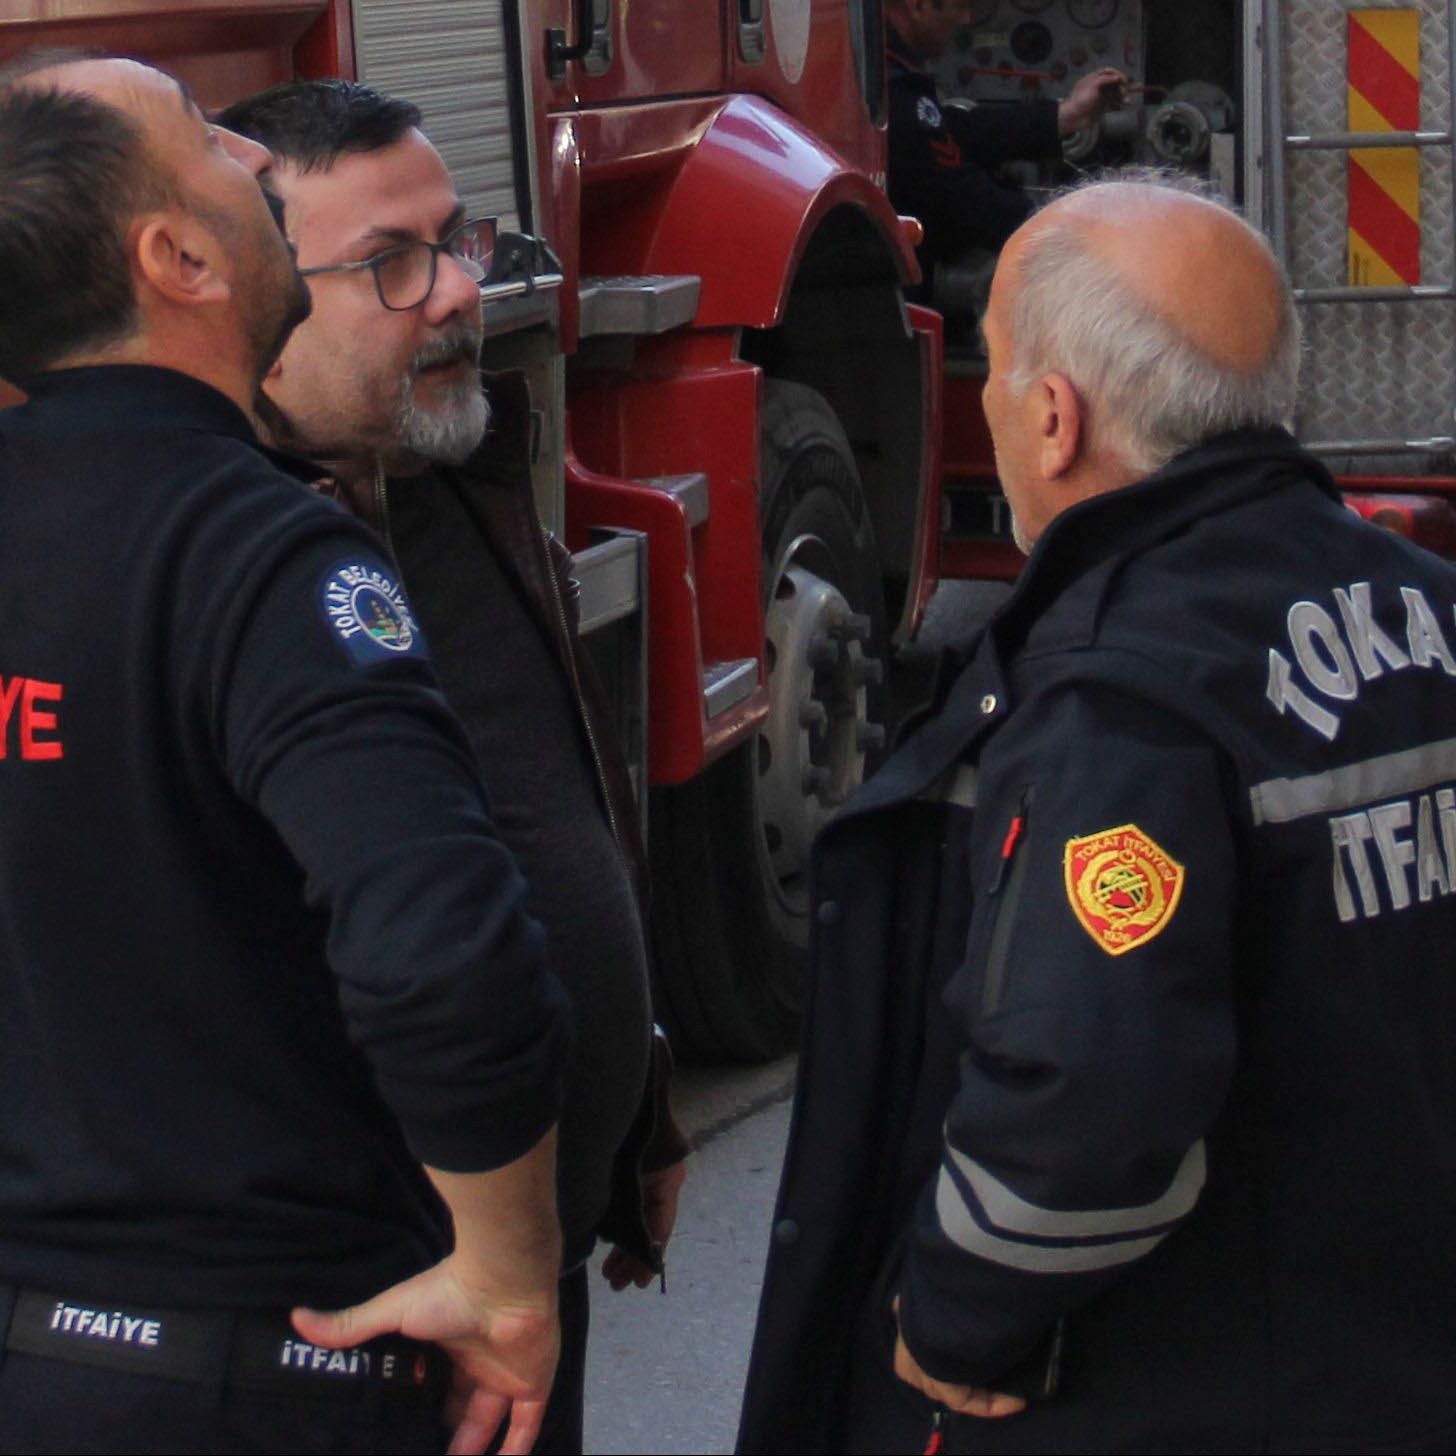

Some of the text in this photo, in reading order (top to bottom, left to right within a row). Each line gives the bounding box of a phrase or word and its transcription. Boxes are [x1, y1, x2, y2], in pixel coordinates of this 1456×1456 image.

[327, 582, 362, 639] TOKAT
[1074, 835, 1121, 861] TOKAT
[50, 1302, 161, 1345] İTFAİYE
